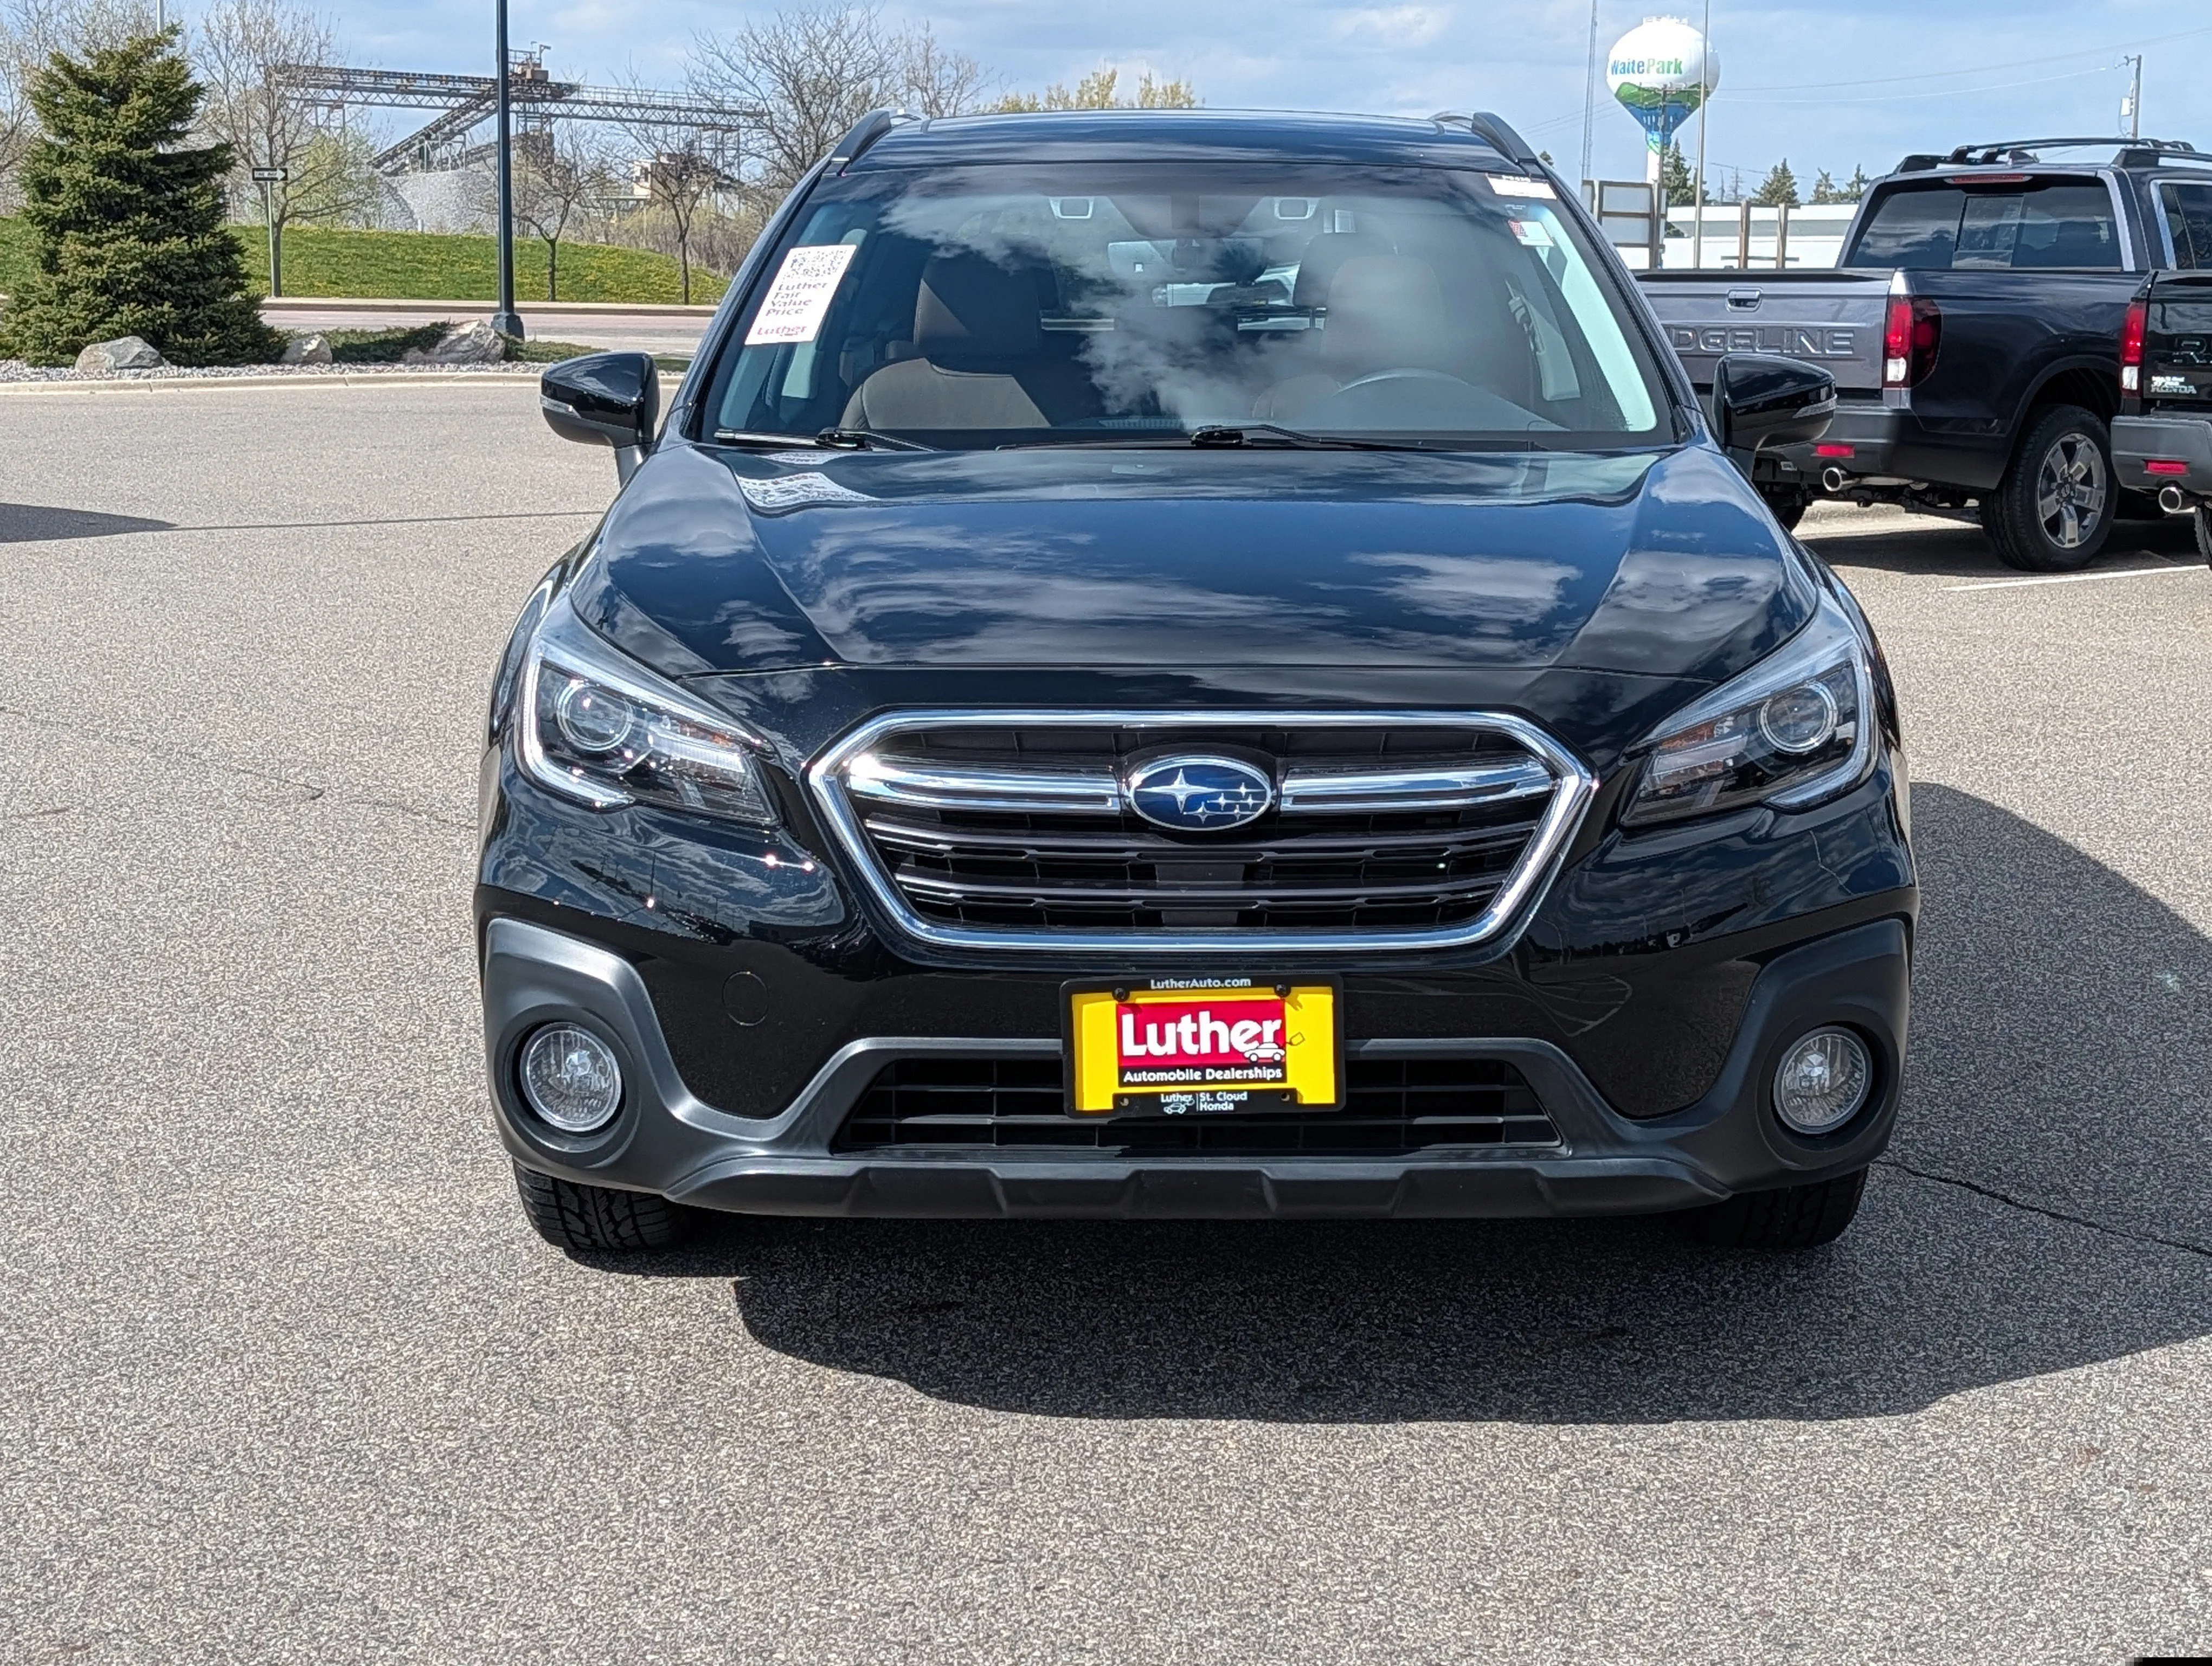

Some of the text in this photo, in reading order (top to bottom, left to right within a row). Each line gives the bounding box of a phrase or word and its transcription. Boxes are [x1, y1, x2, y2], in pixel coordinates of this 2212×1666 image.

[1611, 57, 1682, 75] Waite Park
[779, 282, 827, 291] Luther
[771, 299, 812, 307] Value
[766, 307, 804, 316] Price
[1665, 328, 1854, 354] DGELINE
[1150, 978, 1251, 990] LutherAuto.com
[1122, 1010, 1282, 1056] Luther
[1123, 1067, 1283, 1082] Automobile Dealerships
[1160, 1093, 1193, 1103] Luther
[1199, 1091, 1248, 1101] St. Cloud
[1199, 1101, 1234, 1111] Honda
